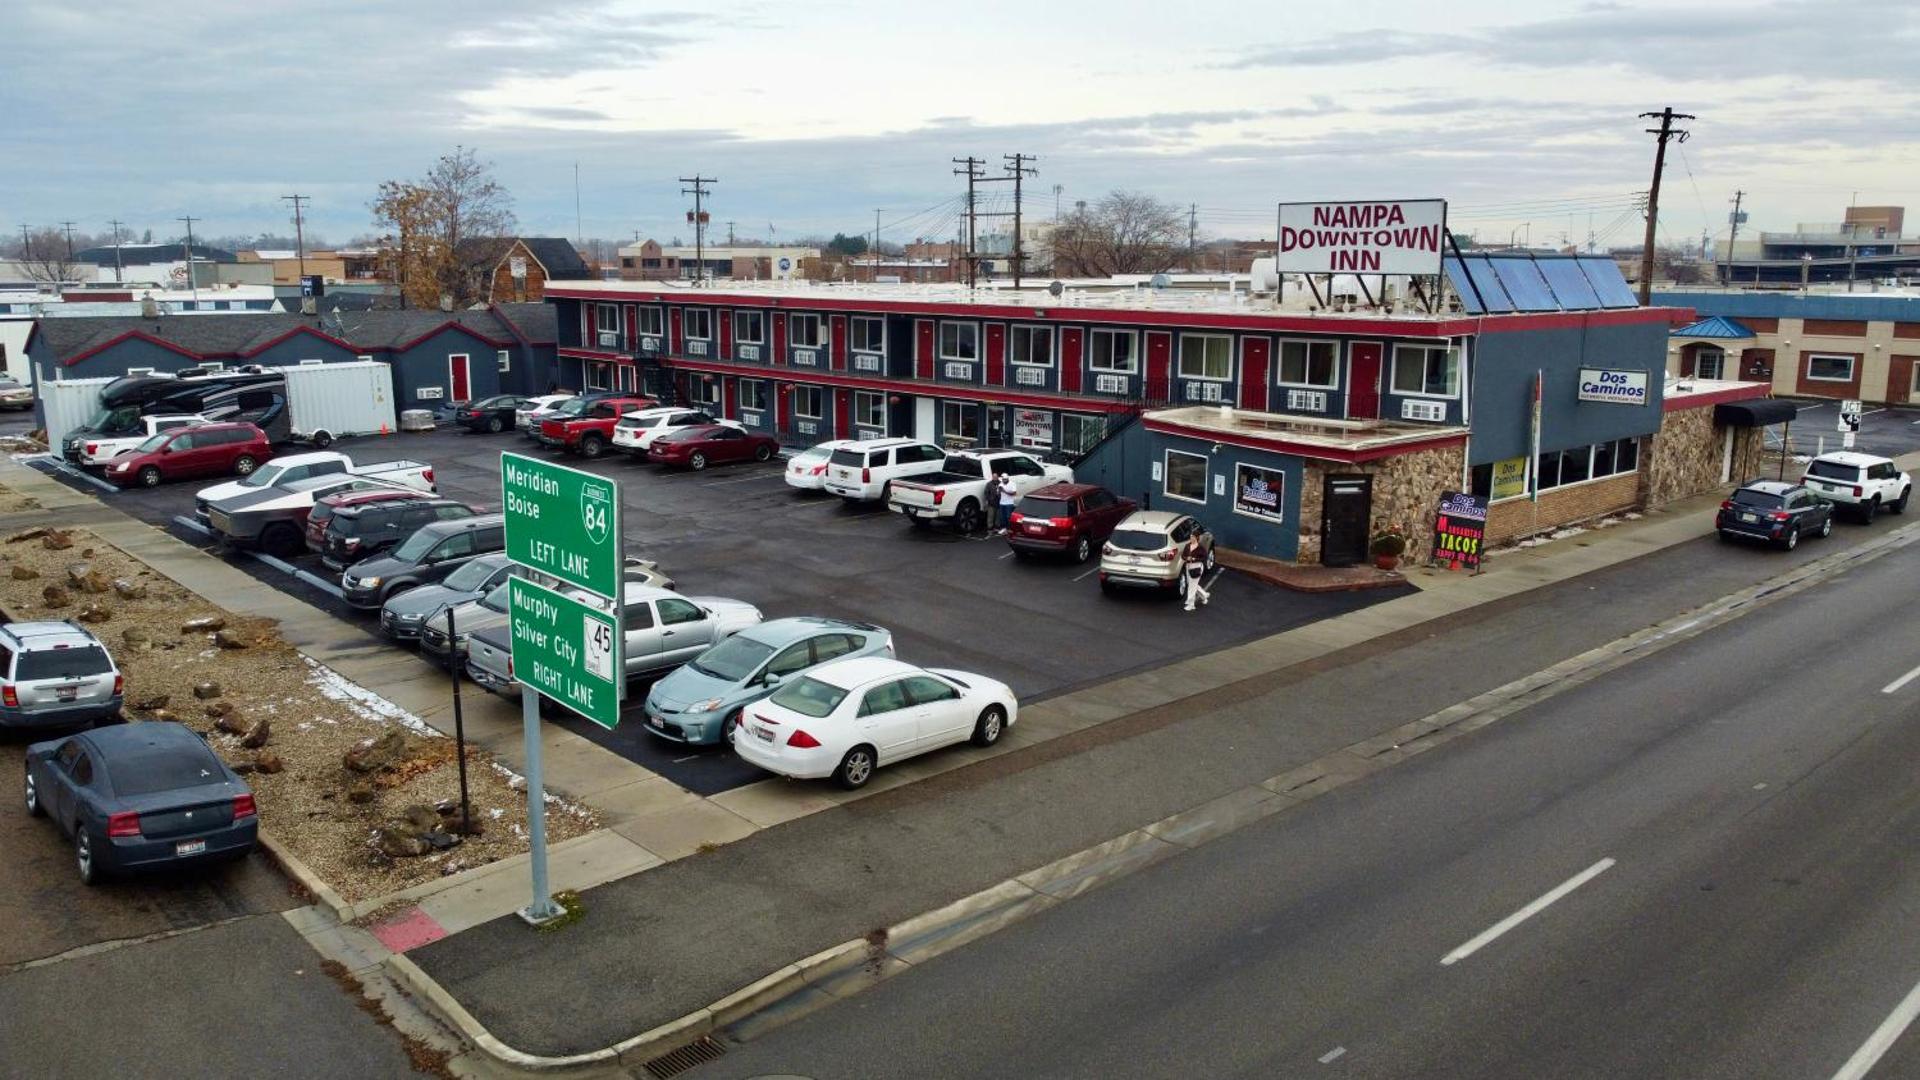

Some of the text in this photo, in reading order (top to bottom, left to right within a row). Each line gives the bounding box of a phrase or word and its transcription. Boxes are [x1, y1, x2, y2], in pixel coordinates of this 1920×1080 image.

[1313, 204, 1406, 229] NAMPA
[1281, 224, 1439, 252] DOWNTOWN
[1330, 250, 1381, 271] INN
[1581, 381, 1645, 397] Caminos
[1599, 371, 1628, 384] Dos
[506, 463, 559, 497] Meridian
[507, 491, 540, 519] Boise
[1441, 501, 1487, 517] Caminos
[1453, 494, 1475, 506] Dos
[585, 503, 606, 534] 84
[1440, 533, 1478, 555] TACOS
[530, 538, 590, 580] LEFT LANE
[513, 586, 558, 626] Murphy
[515, 618, 577, 667] Silver City
[594, 624, 610, 653] 45
[533, 660, 595, 709] RIGHT LANE
